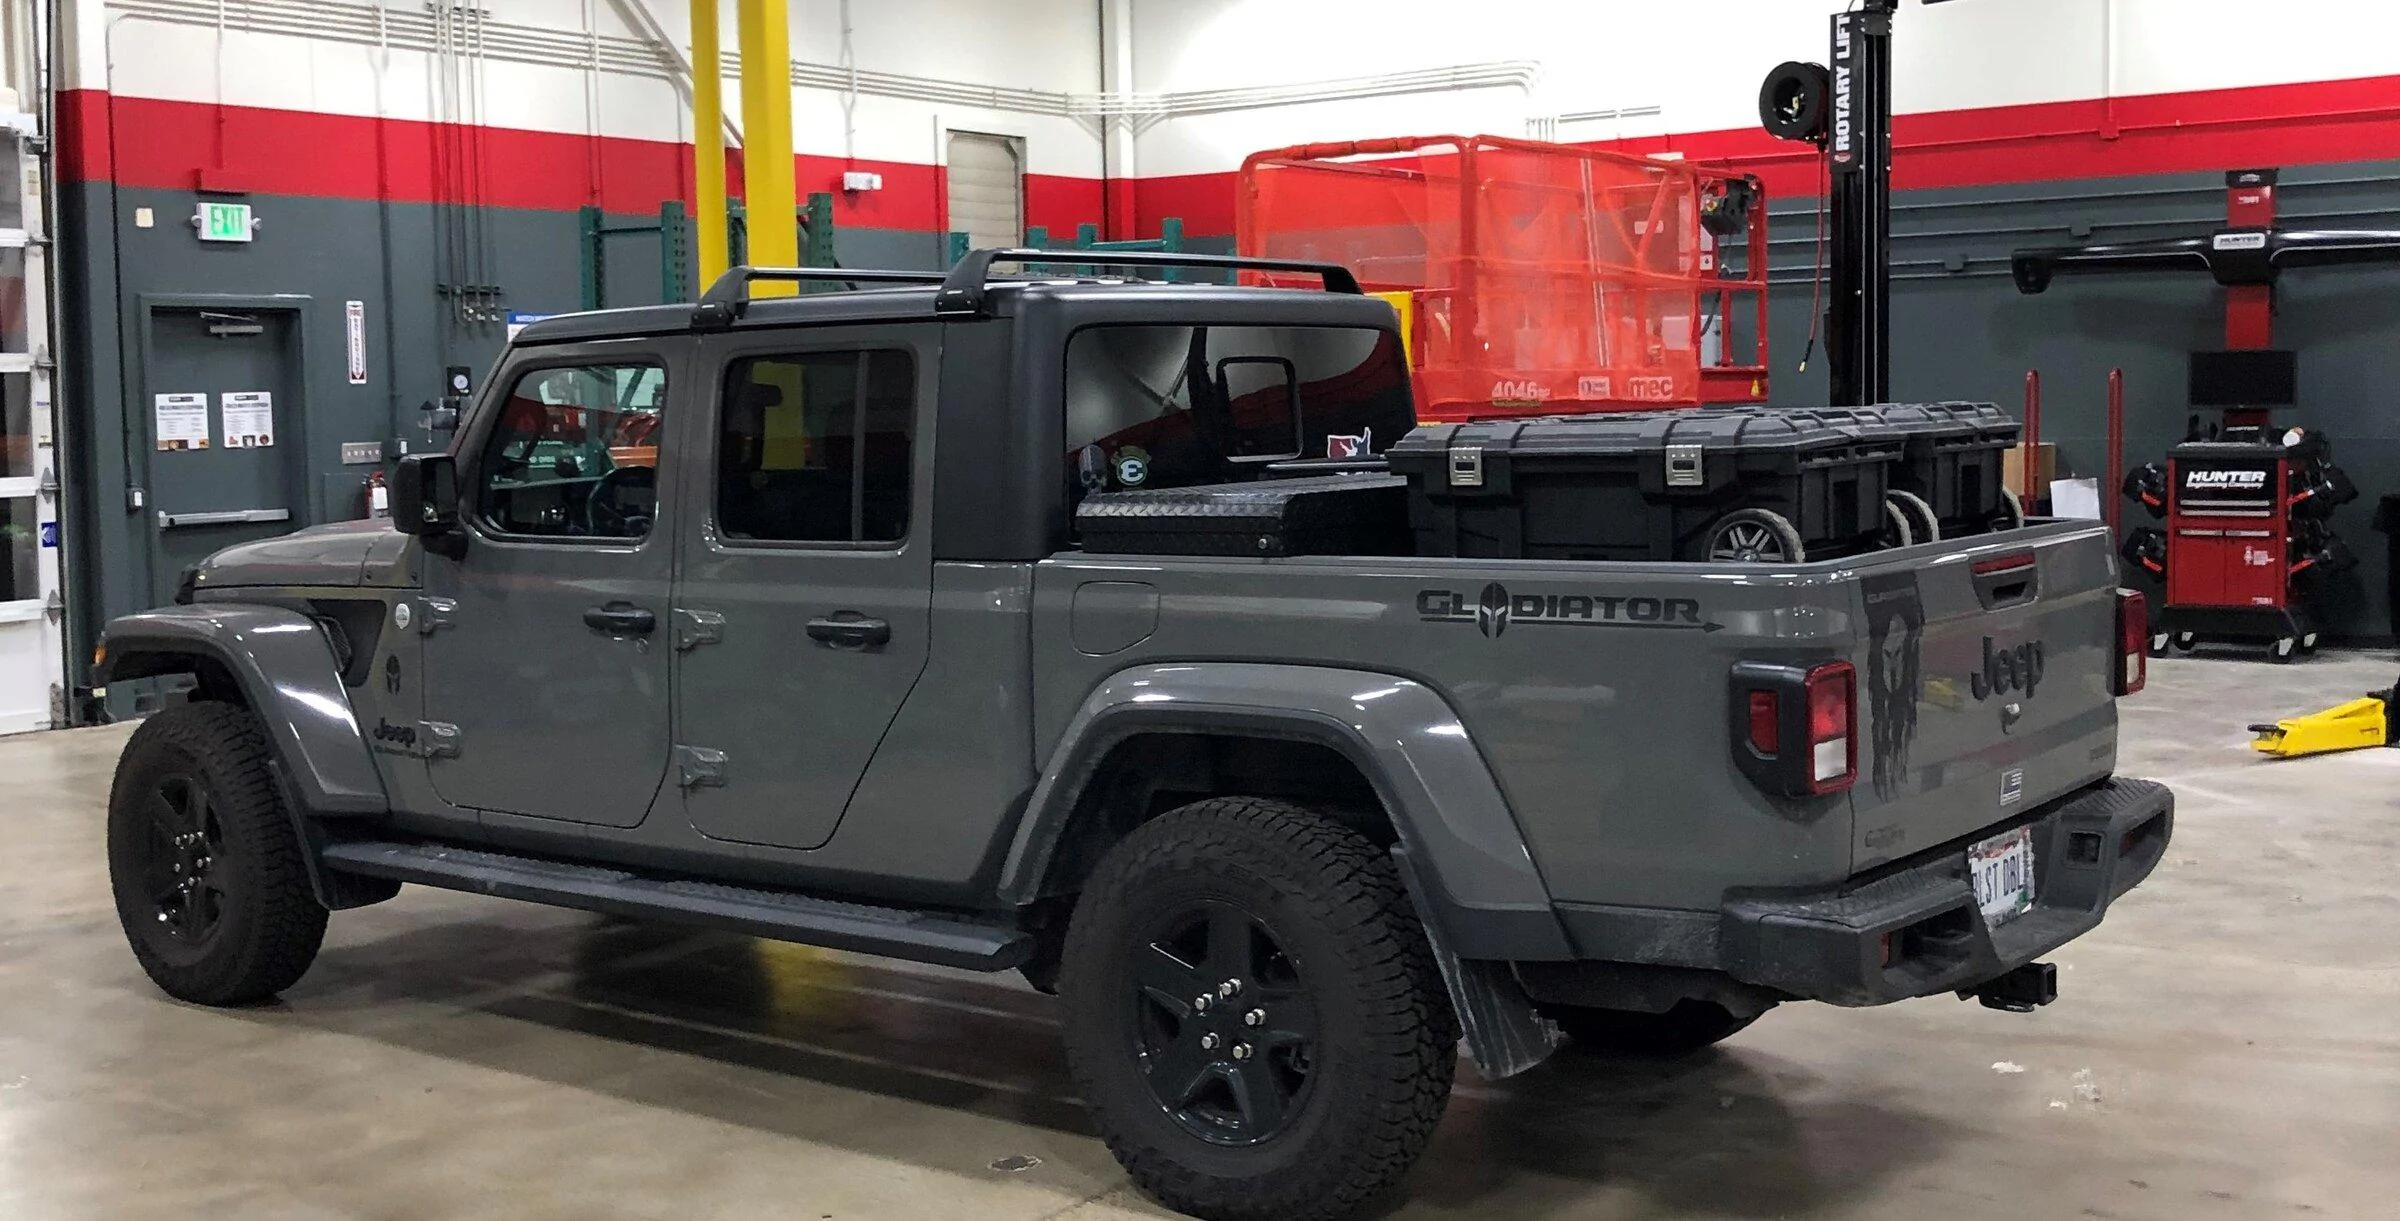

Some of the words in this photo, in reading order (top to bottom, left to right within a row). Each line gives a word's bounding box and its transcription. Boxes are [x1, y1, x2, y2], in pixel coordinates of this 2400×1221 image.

[1836, 14, 1851, 60] LIFT
[1836, 65, 1851, 151] ROTARY
[210, 205, 244, 236] EXIT
[2188, 471, 2267, 482] HUNTER
[1971, 635, 2044, 700] Jeep
[374, 707, 416, 748] Jeep
